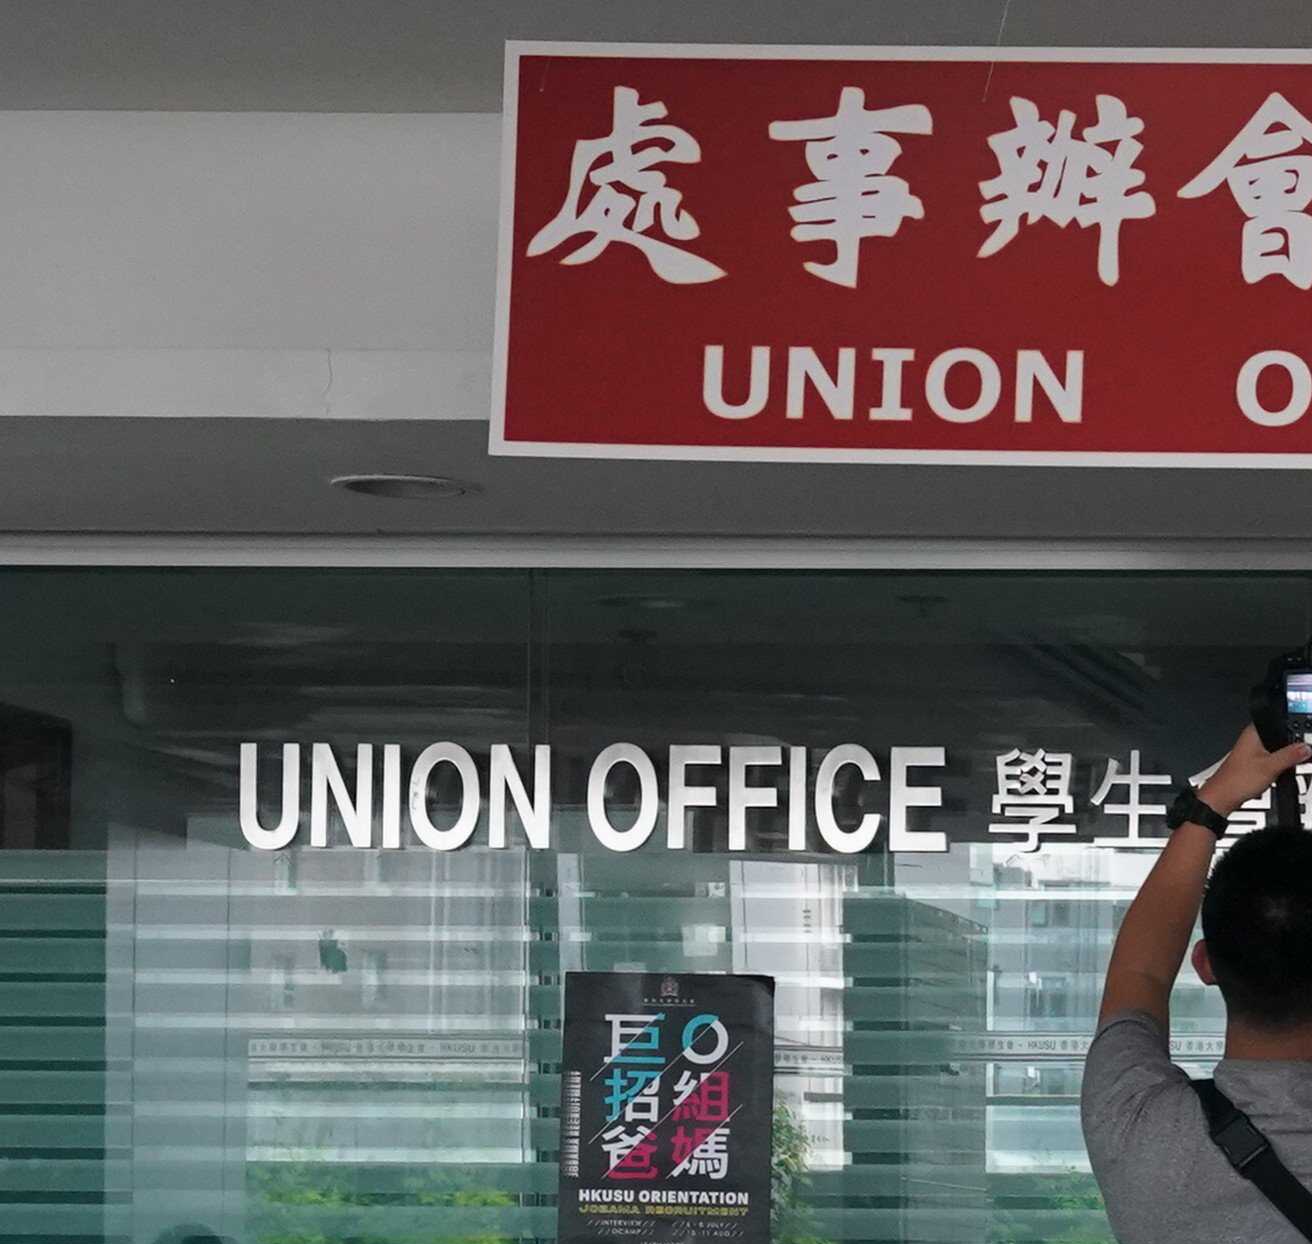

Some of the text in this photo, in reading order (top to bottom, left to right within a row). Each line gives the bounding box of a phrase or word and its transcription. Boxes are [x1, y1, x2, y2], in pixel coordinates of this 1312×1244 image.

[700, 343, 1084, 423] UNION
[239, 742, 947, 853] UNION OFFICE
[578, 1189, 749, 1205] HKUSU ORIENTATION
[645, 1205, 749, 1216] RECRUITMENT
